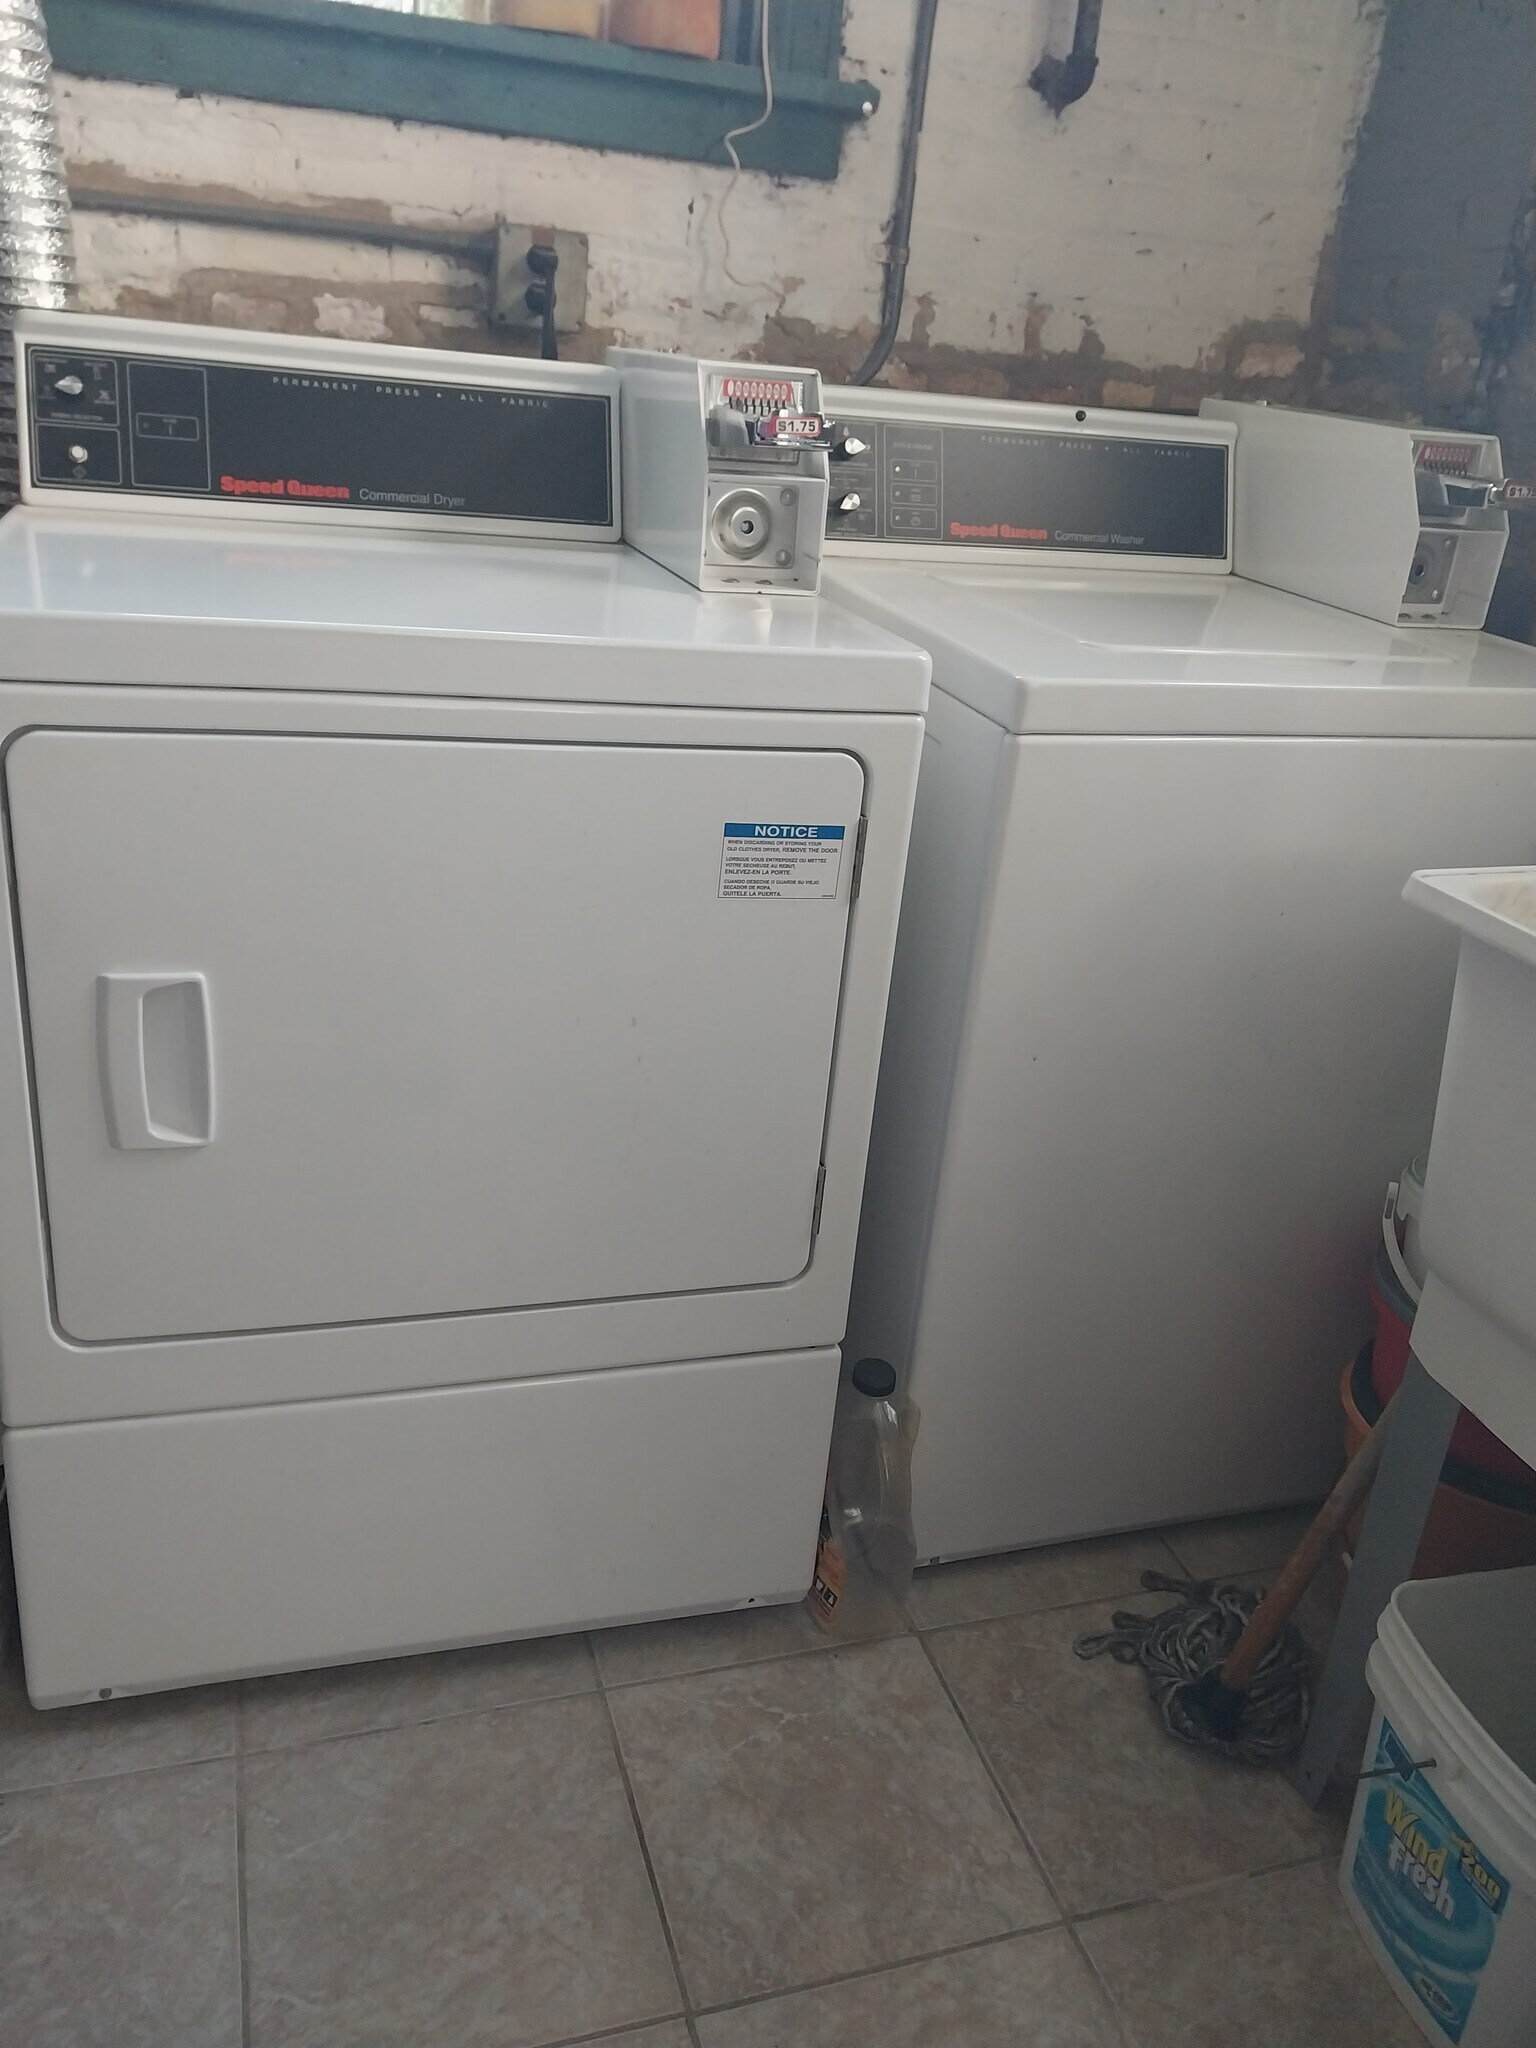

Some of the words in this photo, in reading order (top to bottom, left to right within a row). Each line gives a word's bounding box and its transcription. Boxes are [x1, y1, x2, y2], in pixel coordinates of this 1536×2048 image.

[273, 376, 358, 391] PERMANENT
[376, 386, 419, 397] PRESS
[460, 393, 483, 402] ALL
[778, 420, 816, 432] $1.75
[220, 476, 283, 496] Speed
[287, 480, 349, 499] Queen
[359, 488, 429, 504] Commercial
[434, 494, 466, 508] Dryer
[950, 522, 998, 538] Speed
[1000, 524, 1047, 539] Queen
[1055, 530, 1108, 543] Commercial
[1111, 534, 1144, 544] Washer
[755, 825, 818, 837] NOTICE
[1385, 1786, 1450, 1880] Wind
[1387, 1839, 1456, 1922] Fresh
